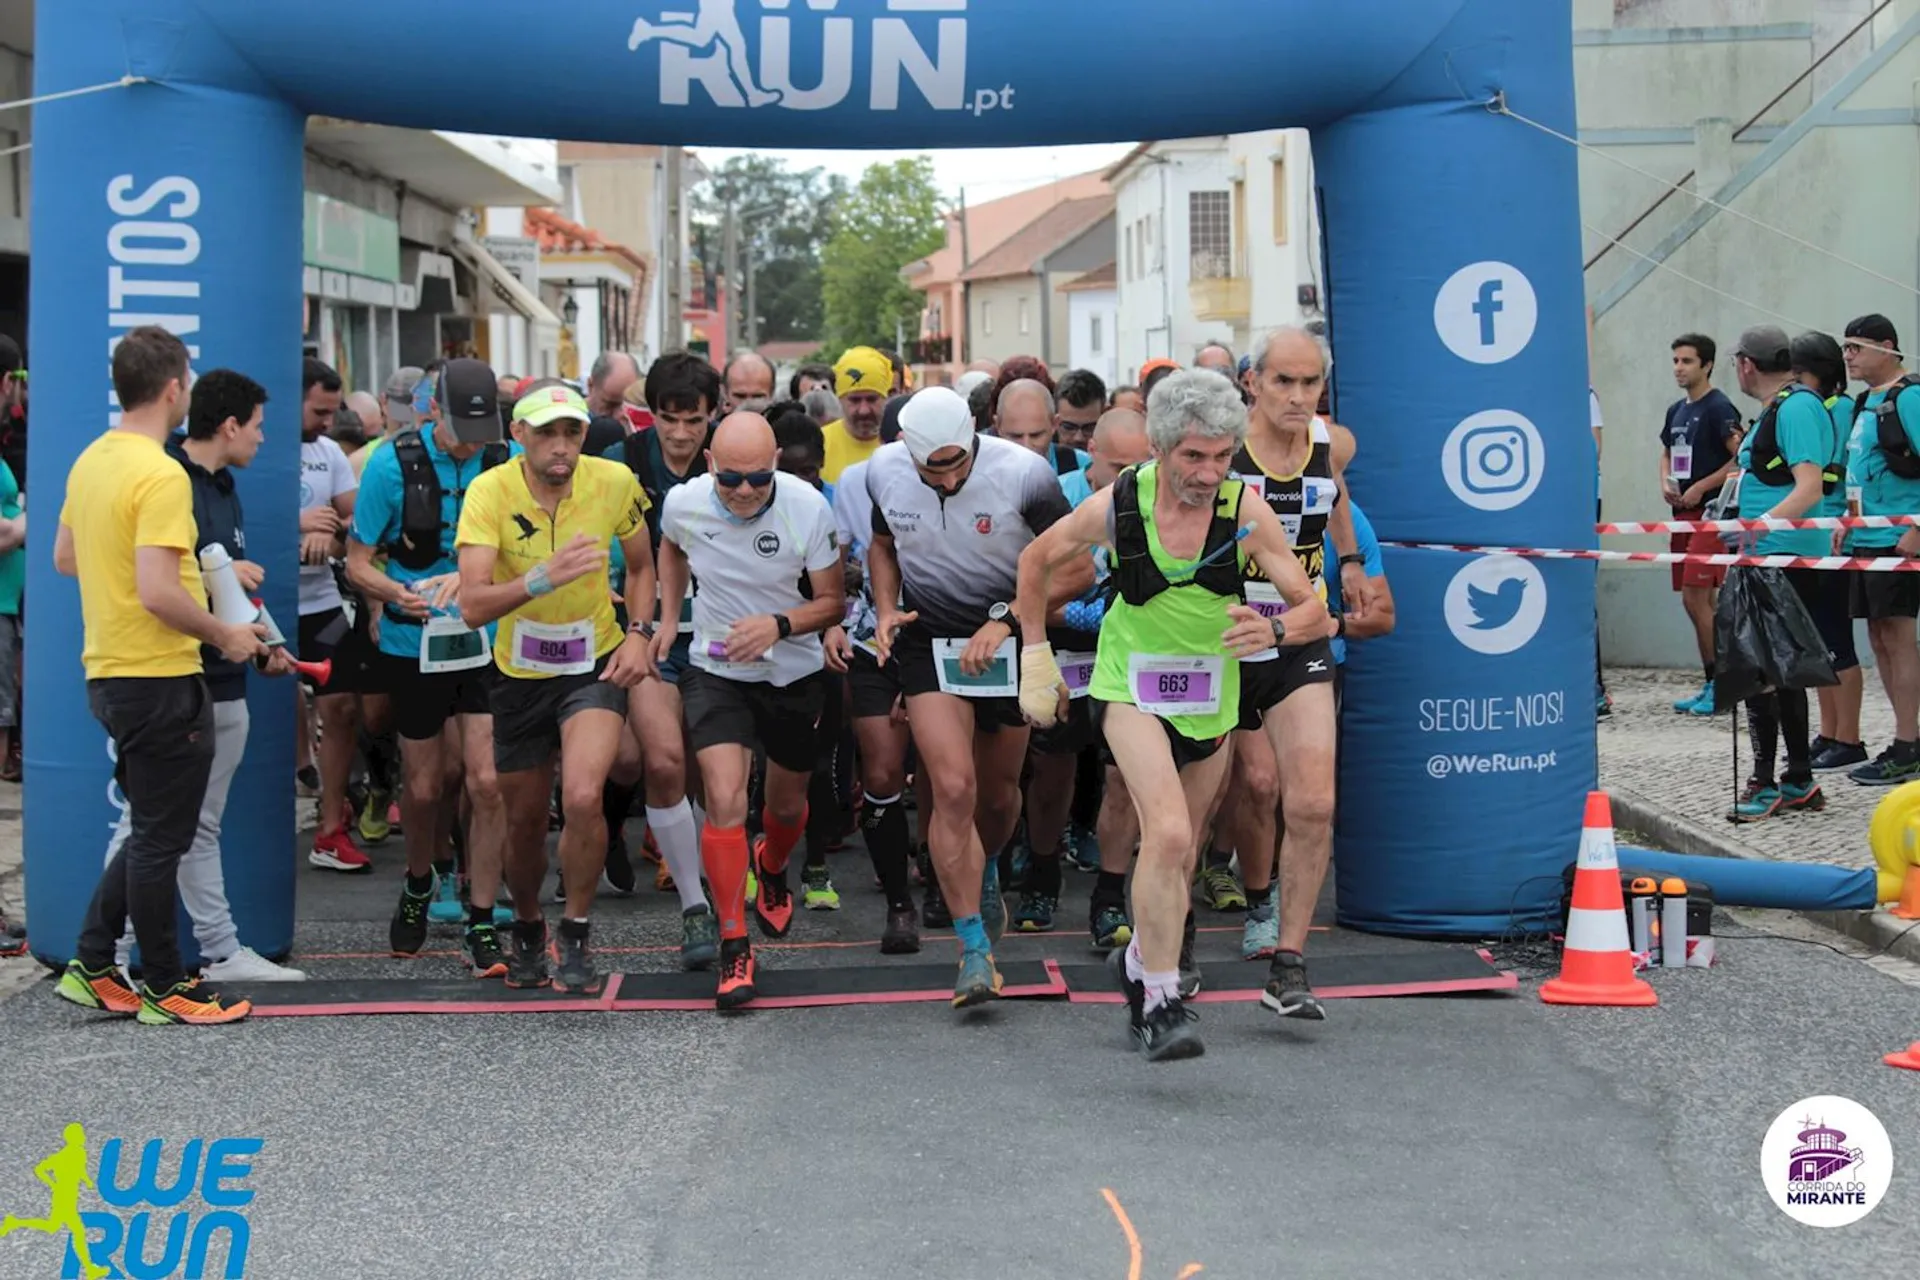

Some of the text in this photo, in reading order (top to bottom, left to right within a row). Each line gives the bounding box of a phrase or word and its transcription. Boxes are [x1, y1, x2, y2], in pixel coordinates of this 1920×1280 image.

[1257, 604, 1283, 617] 701
[539, 641, 567, 657] 604
[1158, 674, 1189, 693] 663
[1418, 690, 1564, 732] SEGUE-NOS!
[1426, 749, 1557, 779] @WeRun.pt
